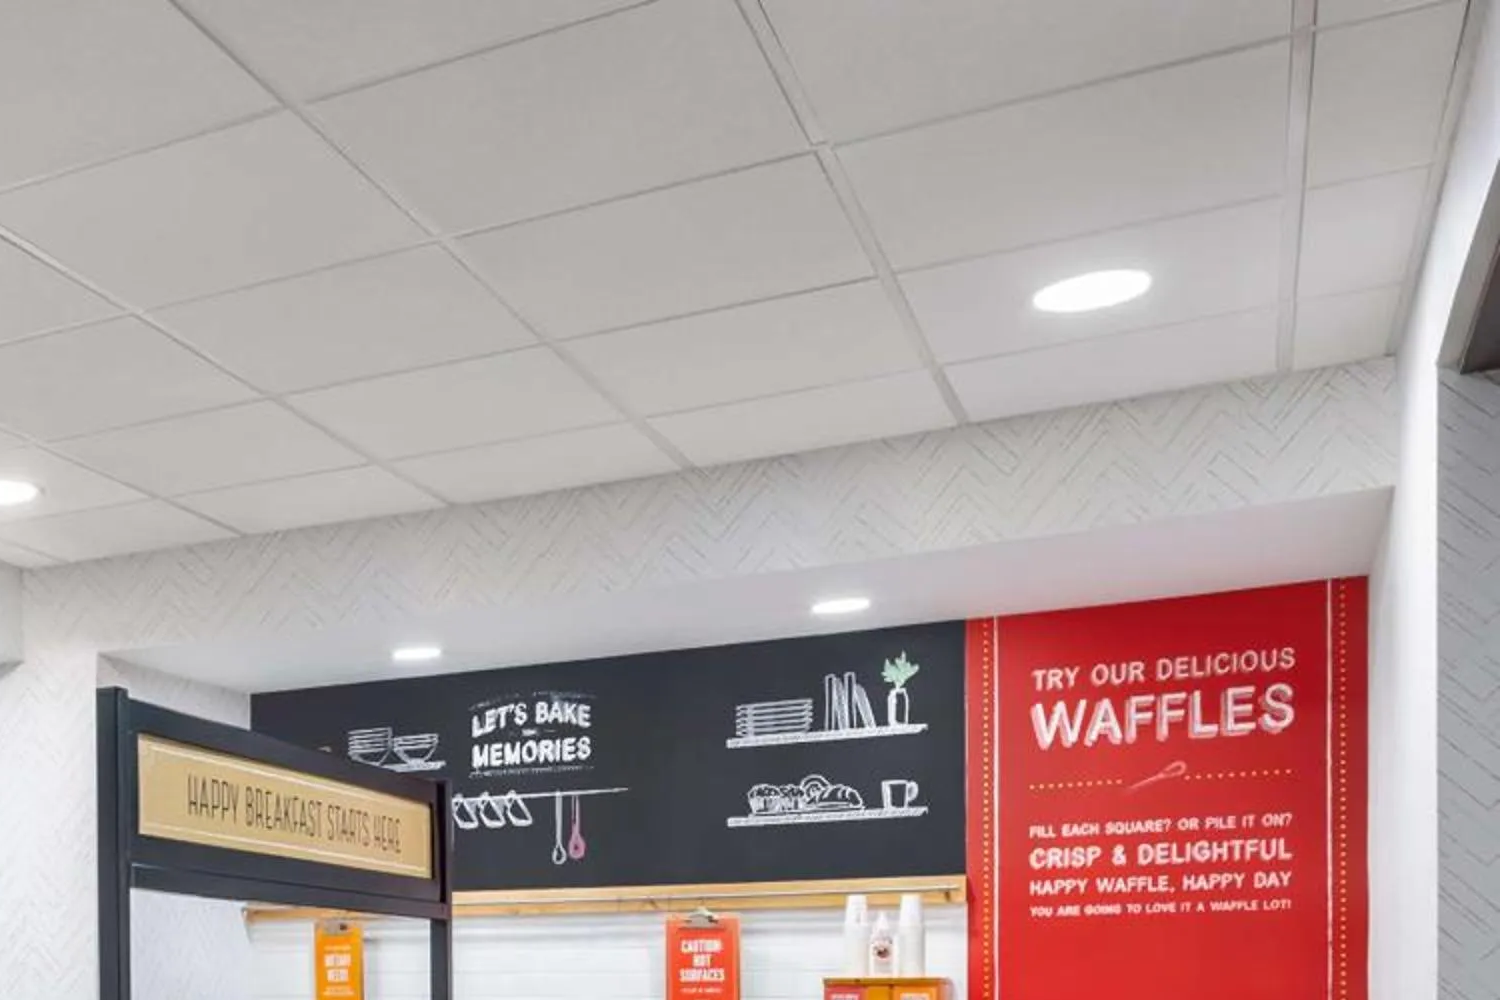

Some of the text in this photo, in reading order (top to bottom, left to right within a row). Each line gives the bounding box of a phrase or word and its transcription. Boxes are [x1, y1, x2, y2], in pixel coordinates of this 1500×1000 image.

[1032, 647, 1296, 691] TRY OUR DELICIOUS
[471, 701, 592, 738] LET'S BAKE
[1030, 683, 1296, 750] WAFFLES
[471, 736, 591, 768] MEMORIES
[187, 774, 402, 854] HAPPY BREAKFAST STARTS HERE
[1029, 813, 1293, 839] FILL EACH SQUARE? OR PILE IT ON?
[1029, 838, 1293, 869] CRISP & DELIGHTFUL
[1029, 871, 1292, 896] HAPPY WAFFLE, HAPPY DAY
[1030, 907, 1052, 918] YOU
[1057, 905, 1081, 916] ARE
[1126, 903, 1142, 914] TO
[1146, 902, 1176, 914] LOVE
[1180, 902, 1191, 912] IT
[1197, 902, 1205, 912] A
[679, 968, 725, 983] SURFACES
[693, 954, 712, 967] HOT
